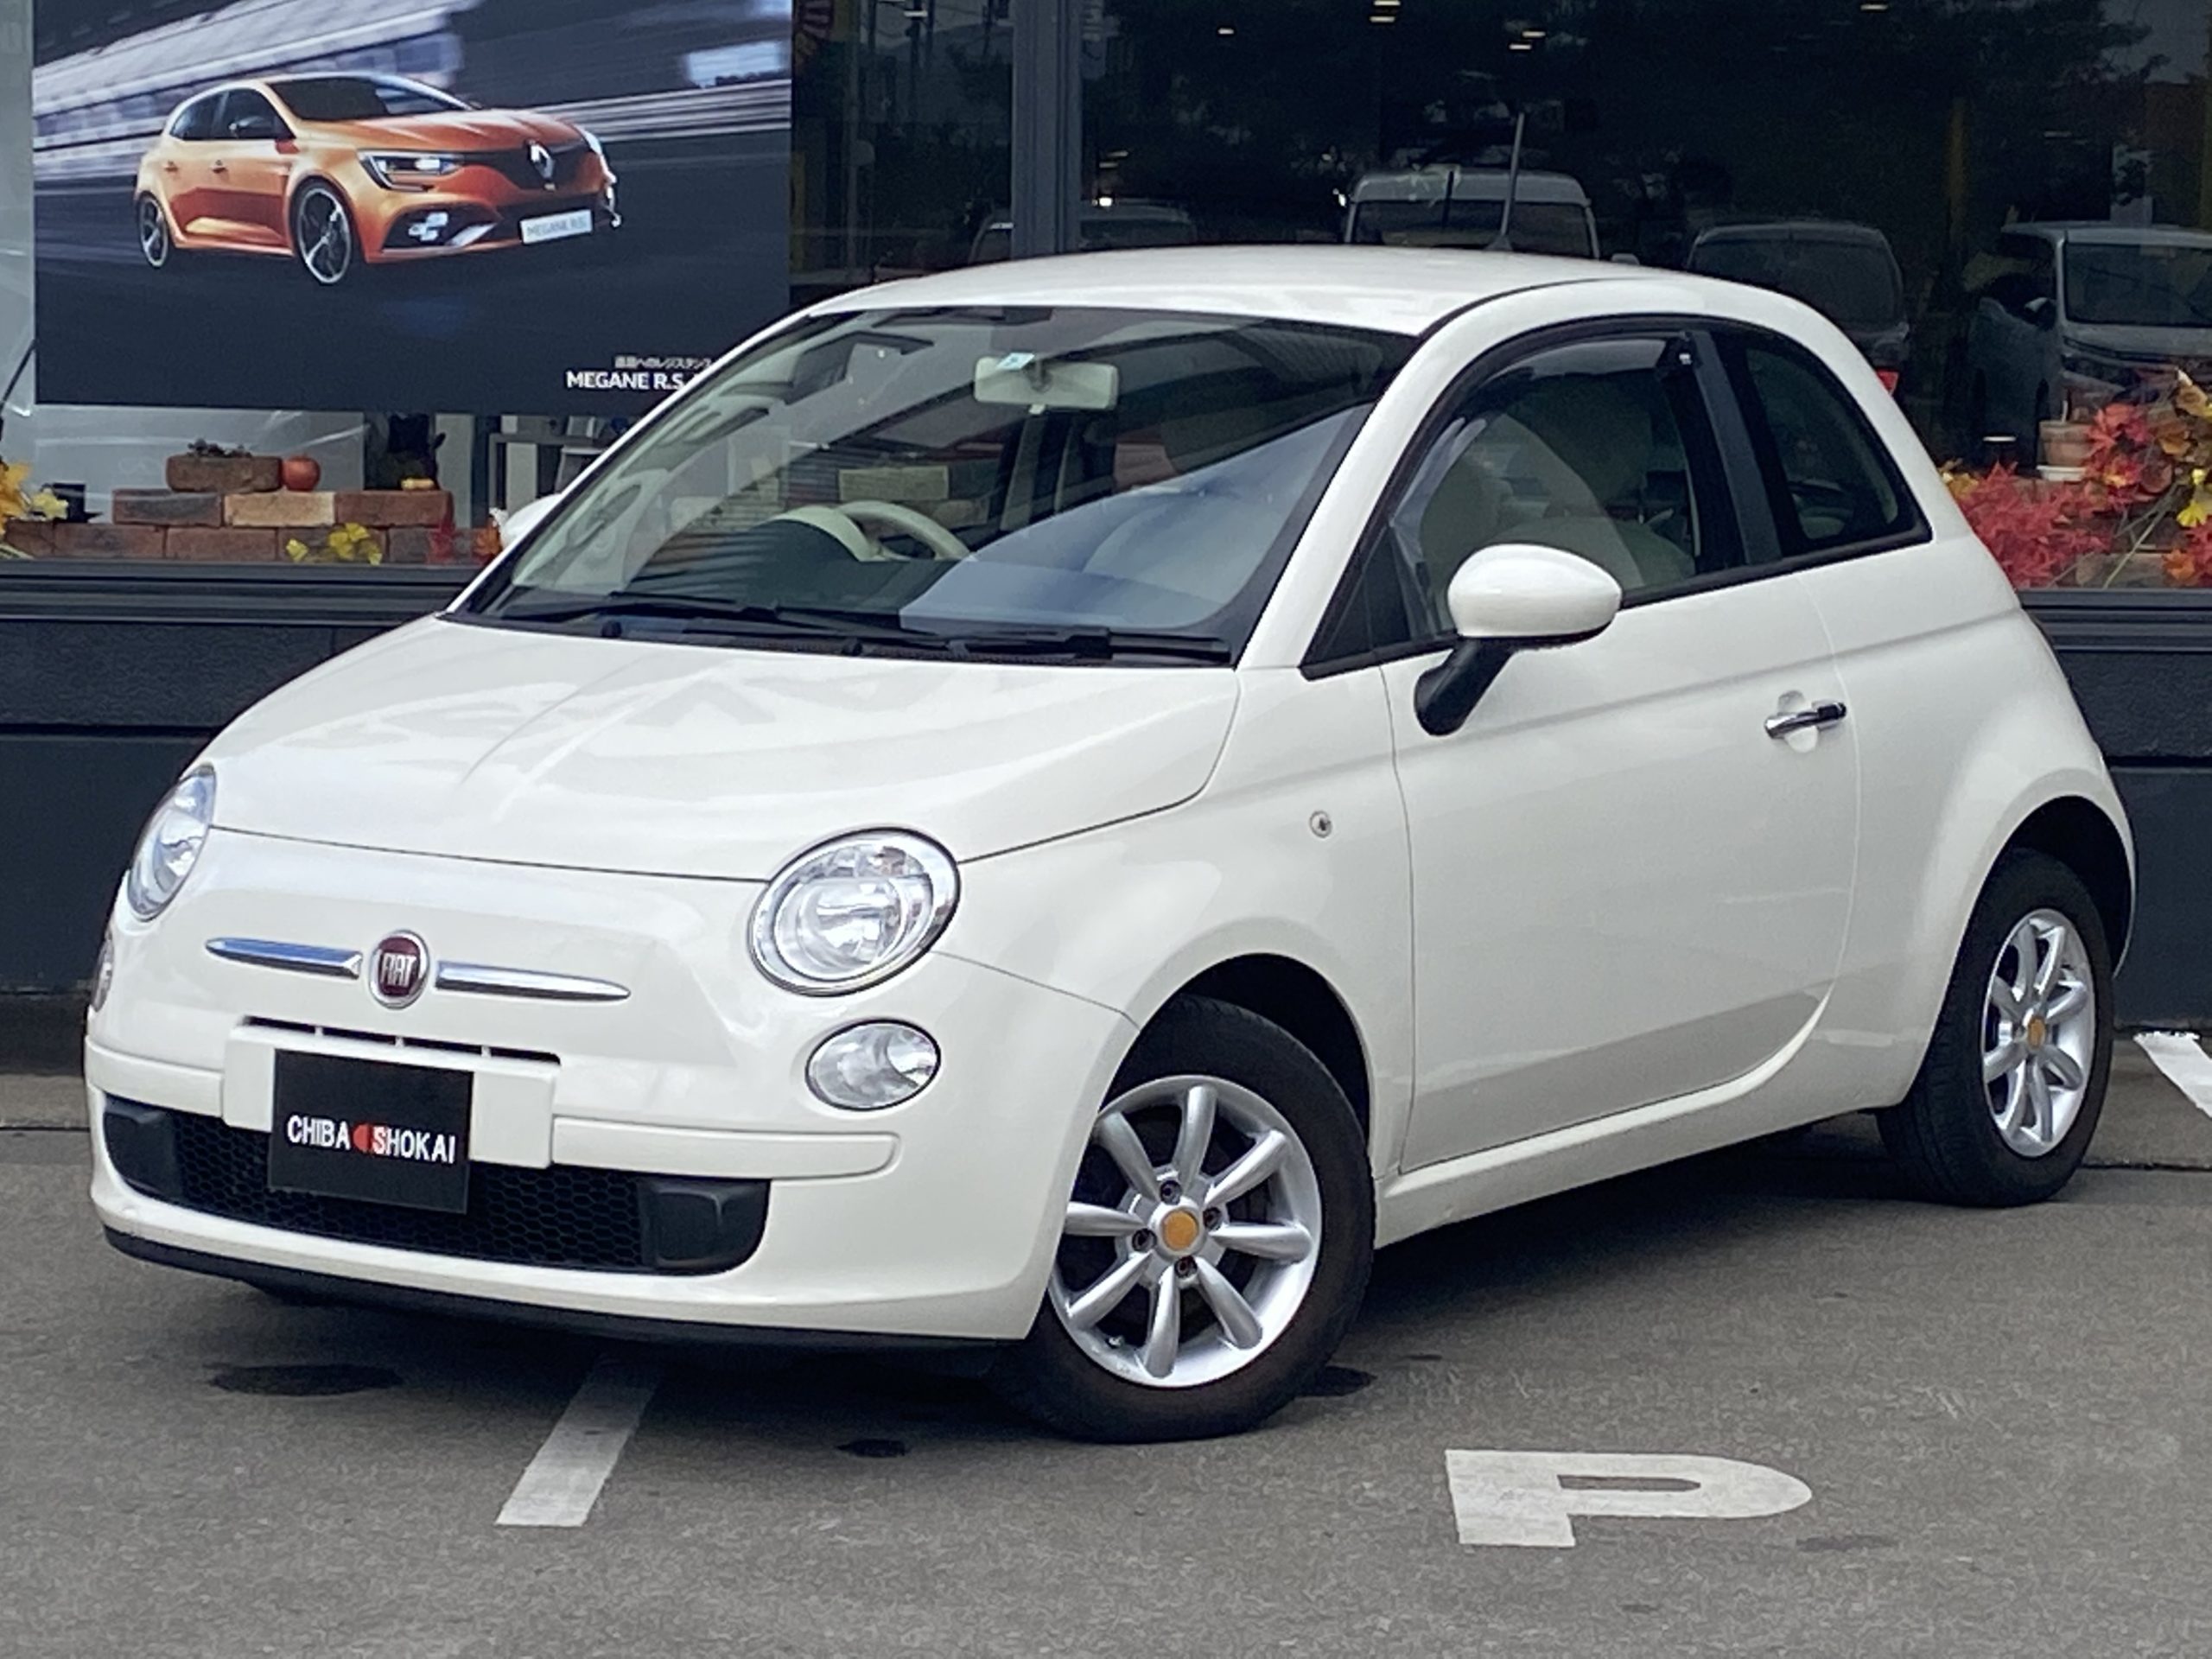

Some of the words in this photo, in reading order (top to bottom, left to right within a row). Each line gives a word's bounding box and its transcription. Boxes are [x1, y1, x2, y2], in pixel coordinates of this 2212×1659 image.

[566, 370, 649, 390] MEGANE
[380, 951, 416, 988] FIAT
[287, 1115, 352, 1150] CHIBA
[372, 1125, 456, 1164] SHOKAI
[1445, 1449, 1813, 1548] P
